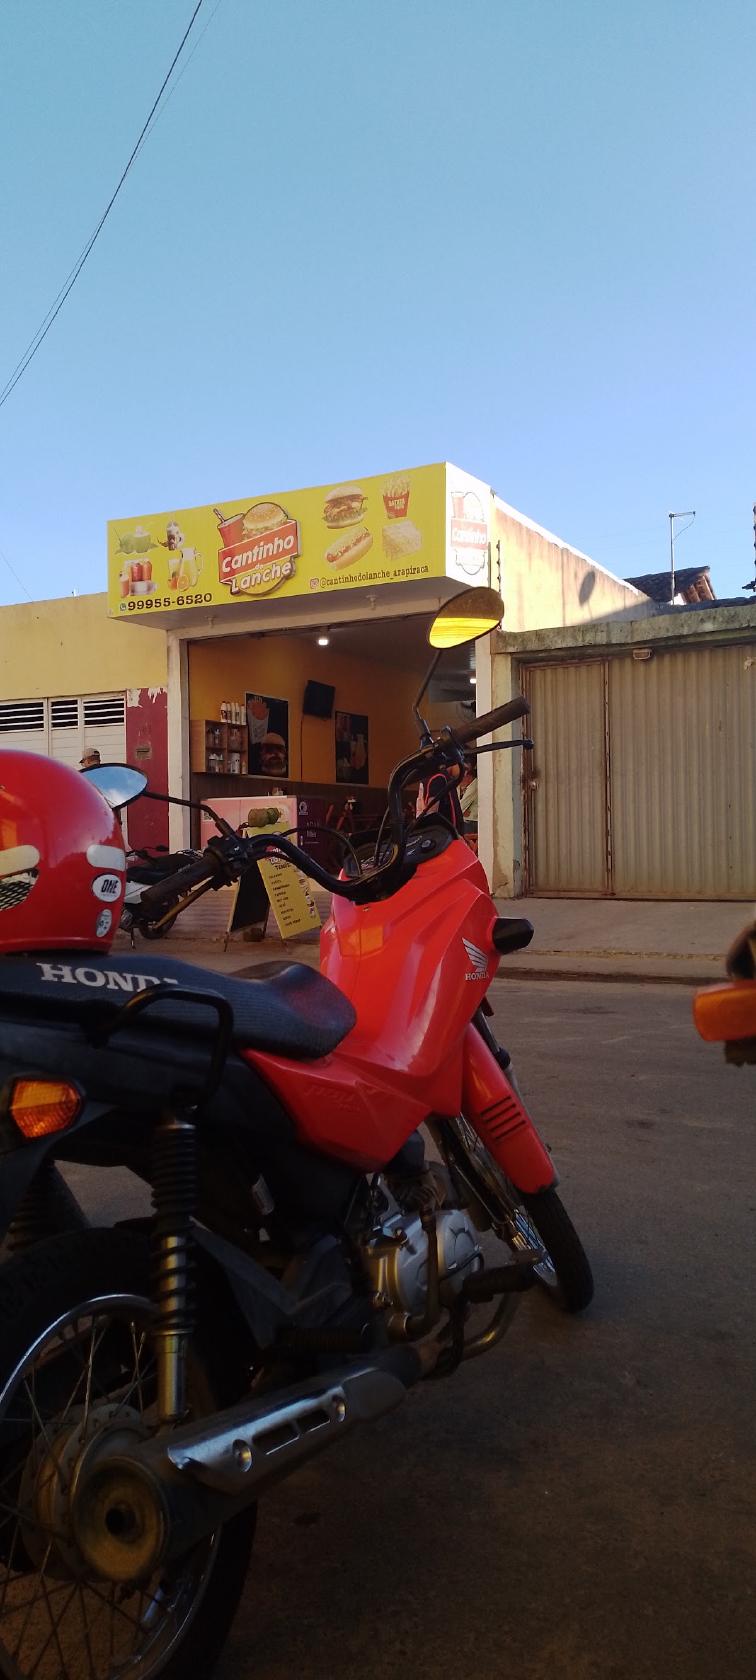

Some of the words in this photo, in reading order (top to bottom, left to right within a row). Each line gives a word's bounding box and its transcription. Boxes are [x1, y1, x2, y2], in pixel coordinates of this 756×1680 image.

[222, 535, 294, 573] Cantinho
[231, 562, 292, 593] Lanche
[127, 592, 213, 611] 99955-6520
[101, 879, 119, 894] ONE
[36, 962, 178, 993] HOND
[465, 972, 489, 981] HONDA
